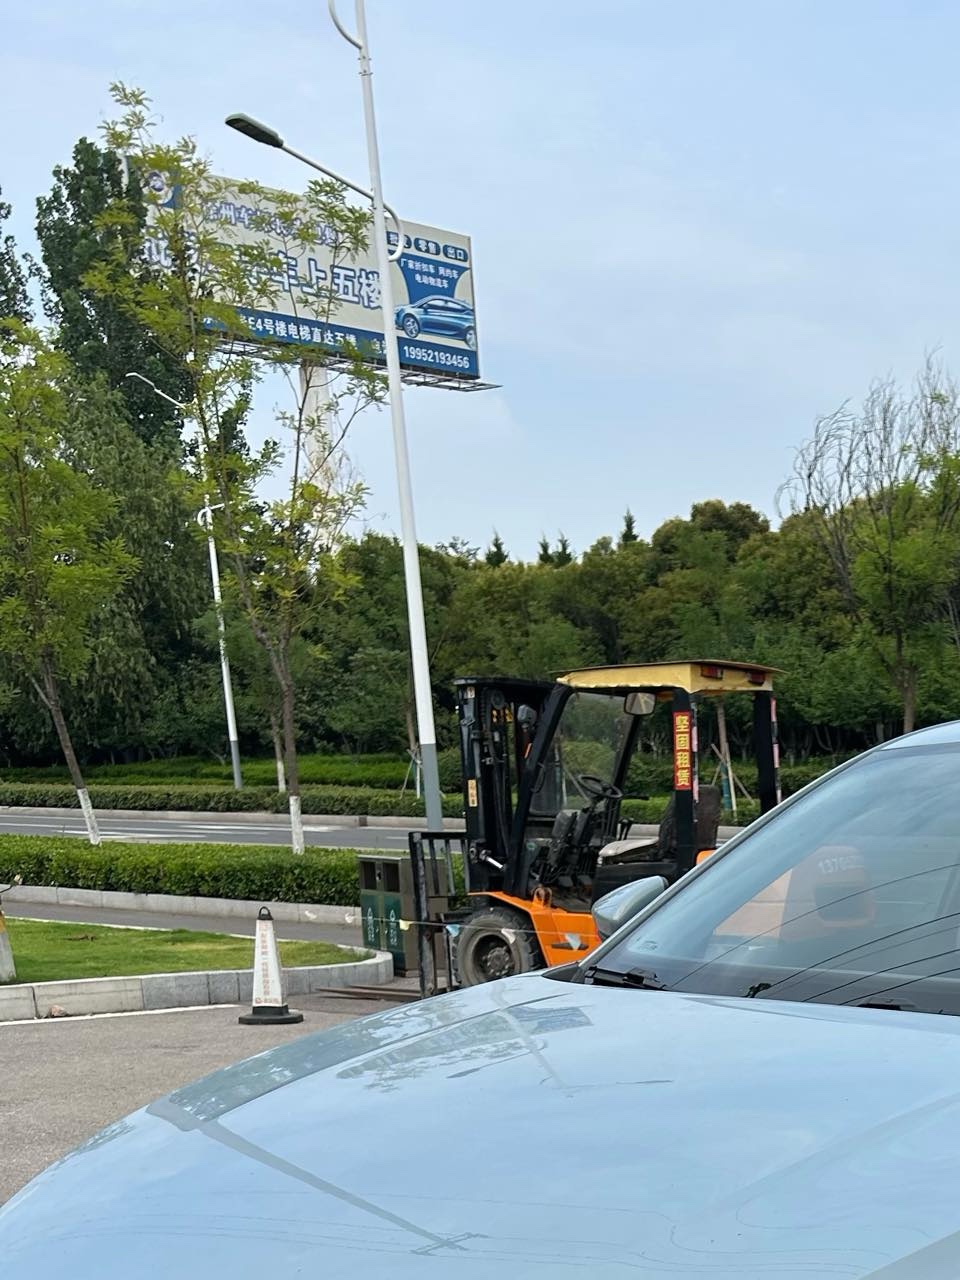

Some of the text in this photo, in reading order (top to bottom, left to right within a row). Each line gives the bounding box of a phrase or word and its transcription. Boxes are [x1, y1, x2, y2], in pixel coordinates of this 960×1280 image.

[418, 239, 438, 255] 零售
[446, 246, 466, 261] 出口
[403, 345, 470, 369] 19952193456
[676, 715, 690, 786] 坚固租赁
